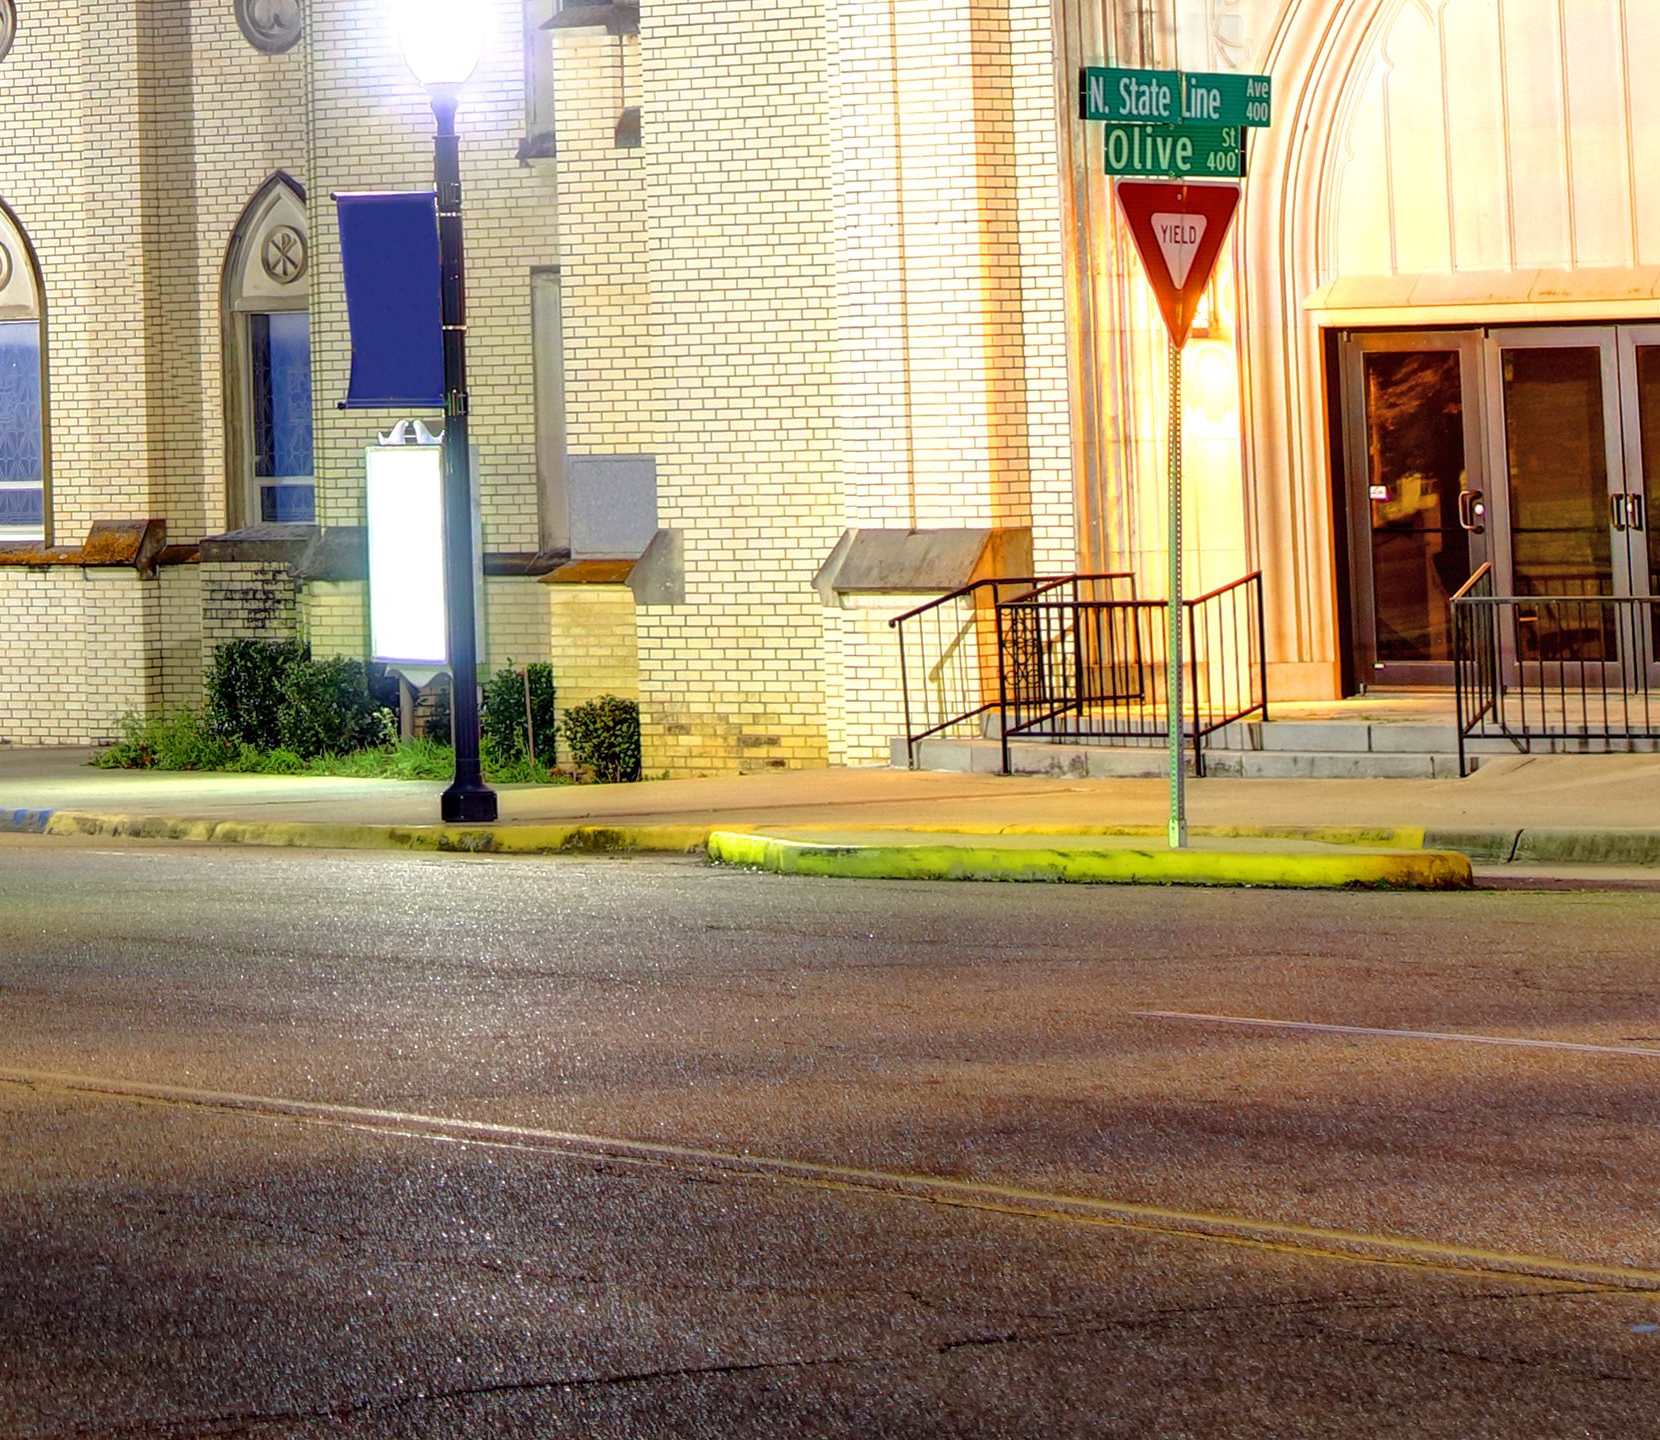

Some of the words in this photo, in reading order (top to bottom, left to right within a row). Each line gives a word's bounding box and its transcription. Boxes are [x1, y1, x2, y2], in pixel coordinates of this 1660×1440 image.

[1090, 76, 1110, 114] N.
[1119, 77, 1171, 117] State
[1180, 77, 1222, 119] Line
[1246, 78, 1269, 99] Ave
[1246, 102, 1269, 122] 400
[1222, 127, 1237, 148] St
[1108, 126, 1193, 171] Olive
[1206, 151, 1237, 172] 400
[1161, 224, 1197, 245] YIELD
